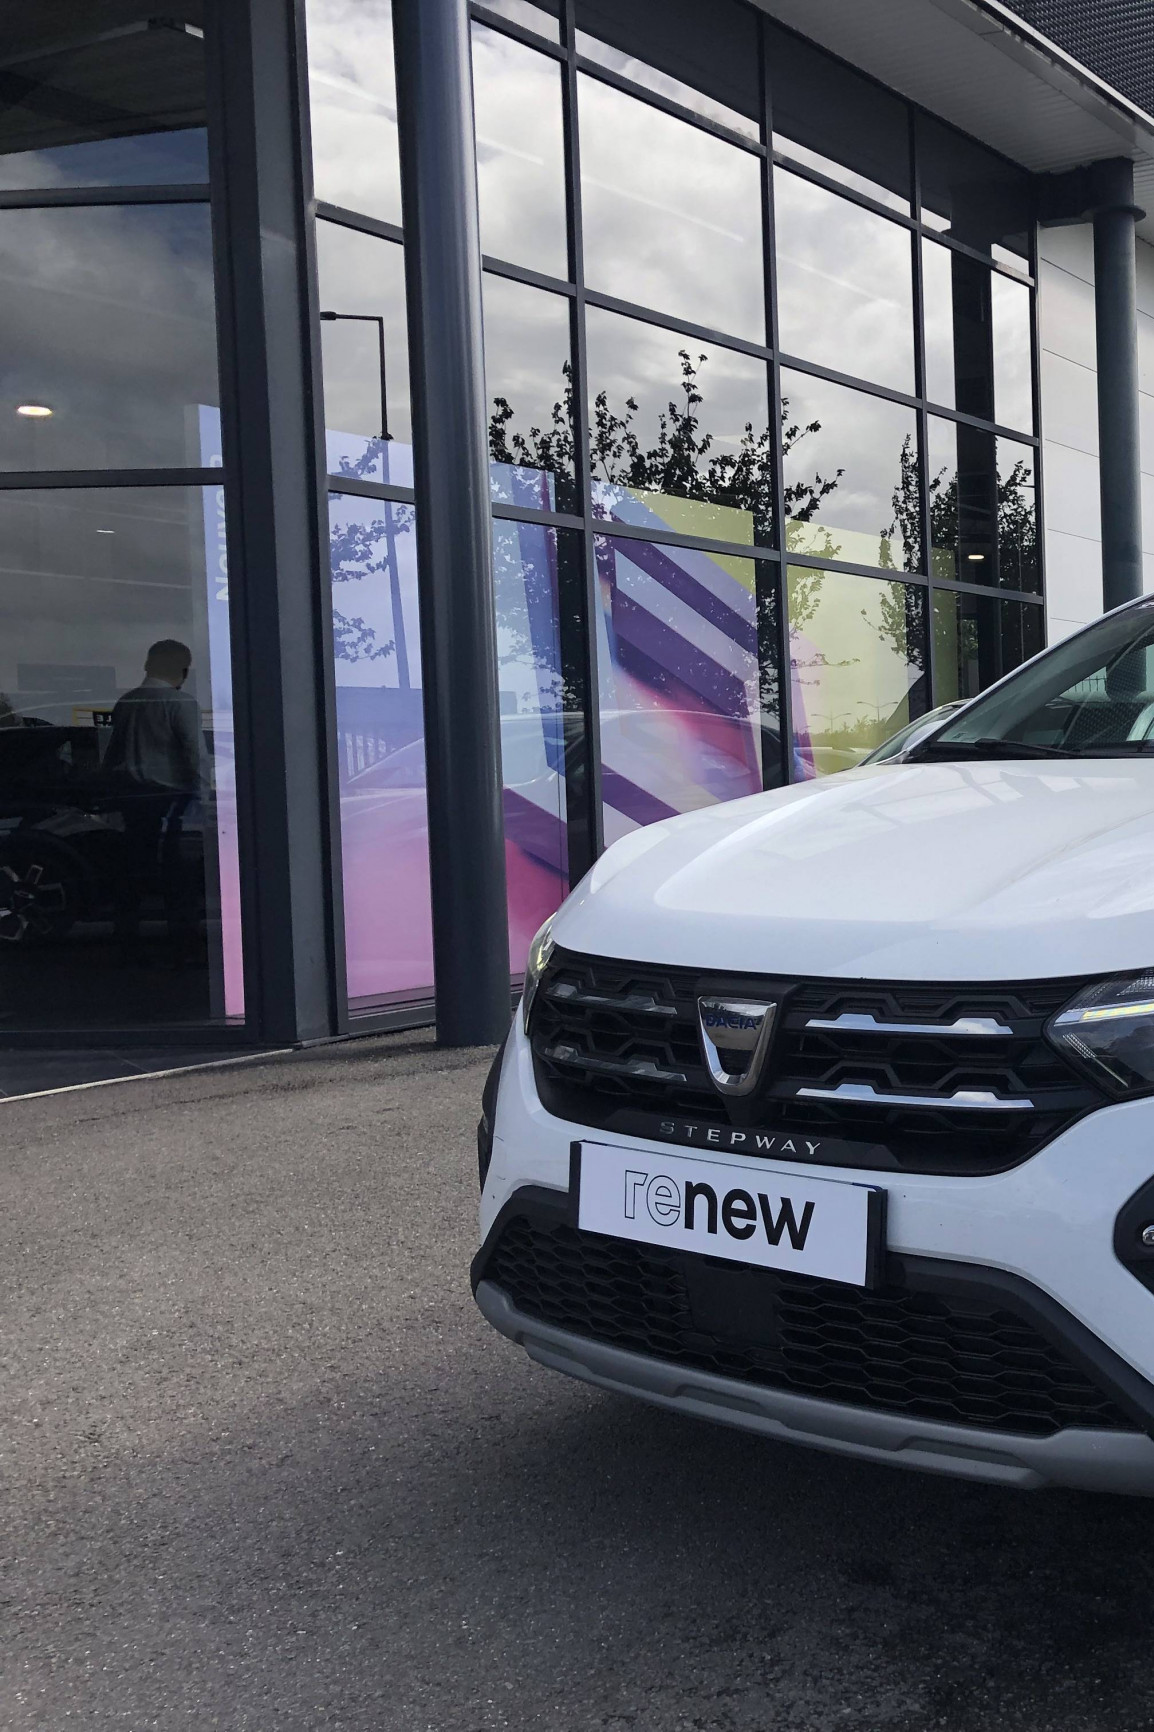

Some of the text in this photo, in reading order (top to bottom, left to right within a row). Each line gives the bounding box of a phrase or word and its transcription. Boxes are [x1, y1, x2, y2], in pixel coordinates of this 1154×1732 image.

[705, 1013, 757, 1030] DACIA
[659, 1121, 821, 1155] STEPWAY
[624, 1169, 816, 1252] renew
